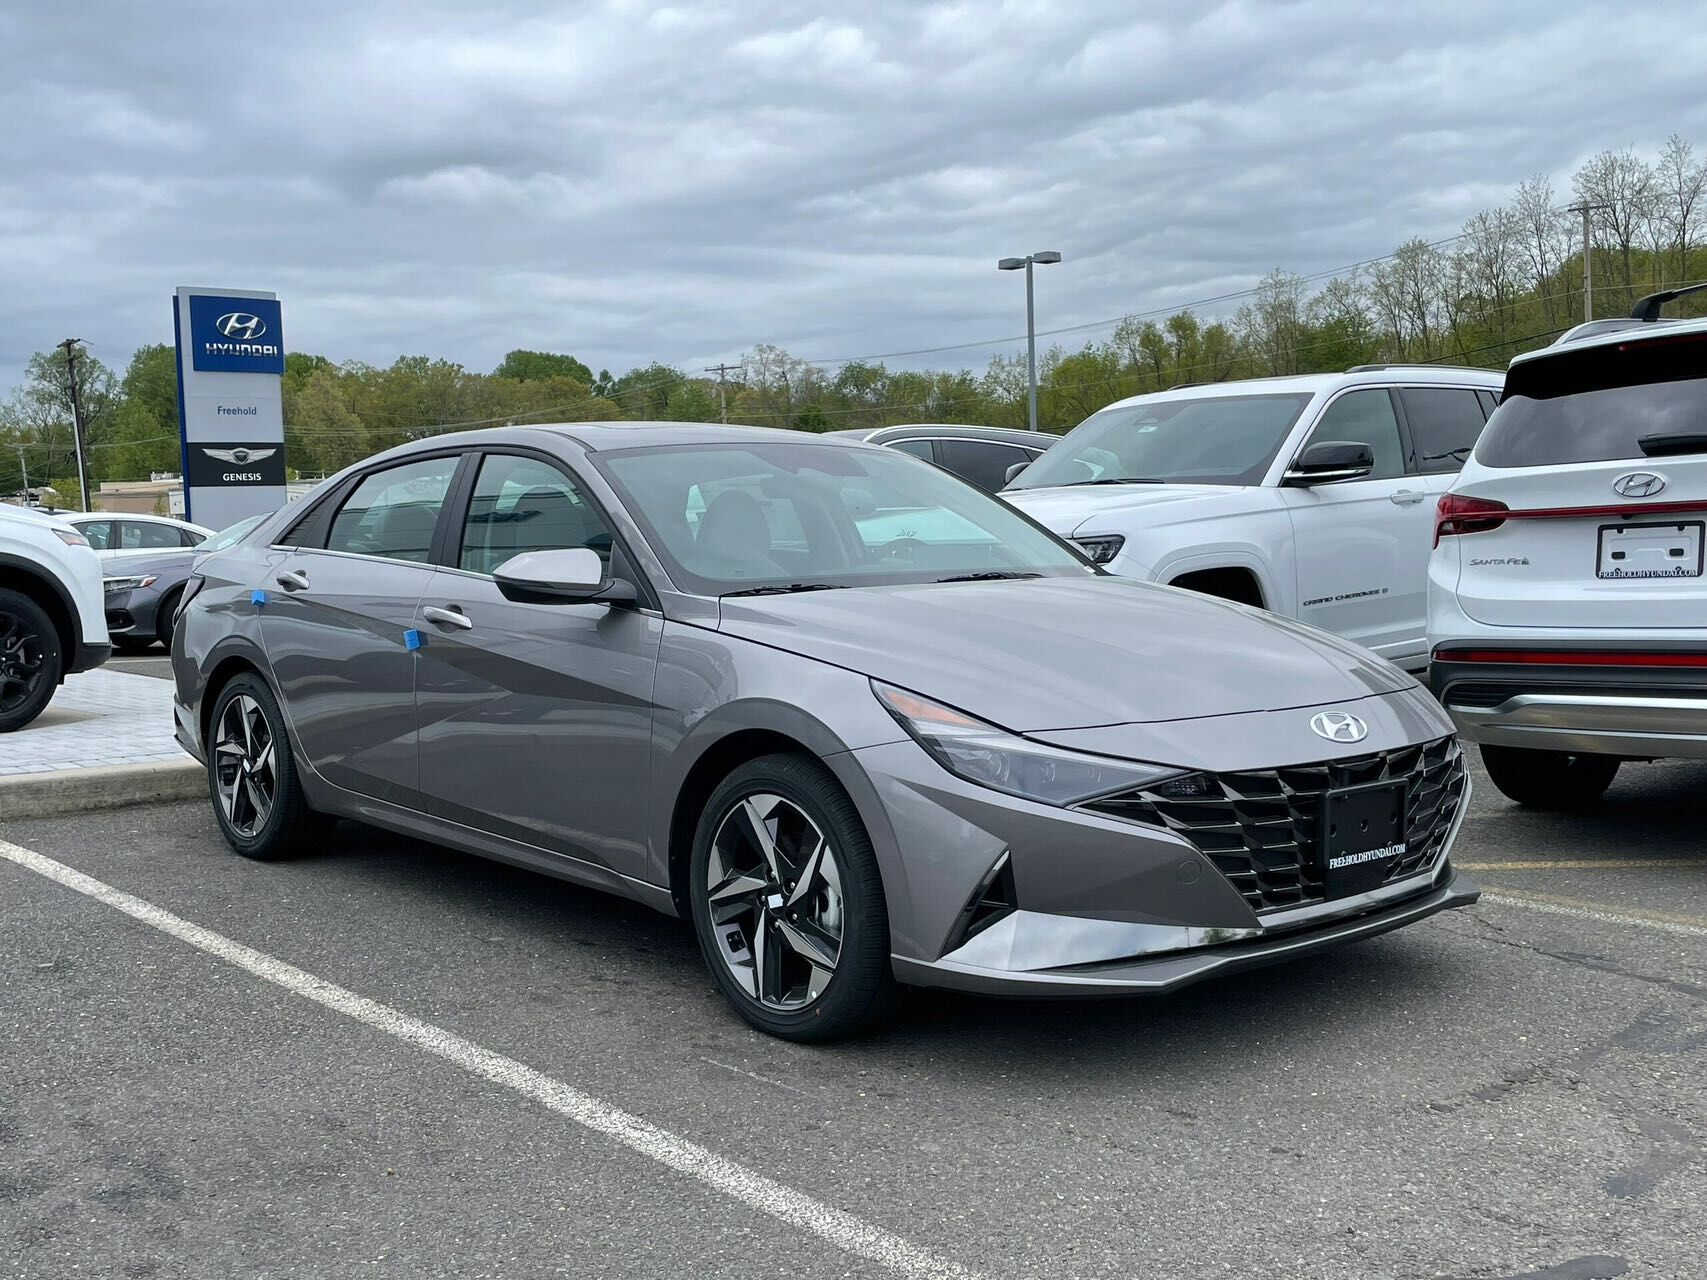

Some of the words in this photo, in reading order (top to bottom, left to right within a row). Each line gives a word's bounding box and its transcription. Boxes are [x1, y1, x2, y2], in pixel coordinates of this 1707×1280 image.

[205, 342, 278, 358] HYUNDAI
[217, 405, 257, 416] Freehold
[222, 472, 262, 481] GENESIS
[1469, 558, 1506, 566] SANTA
